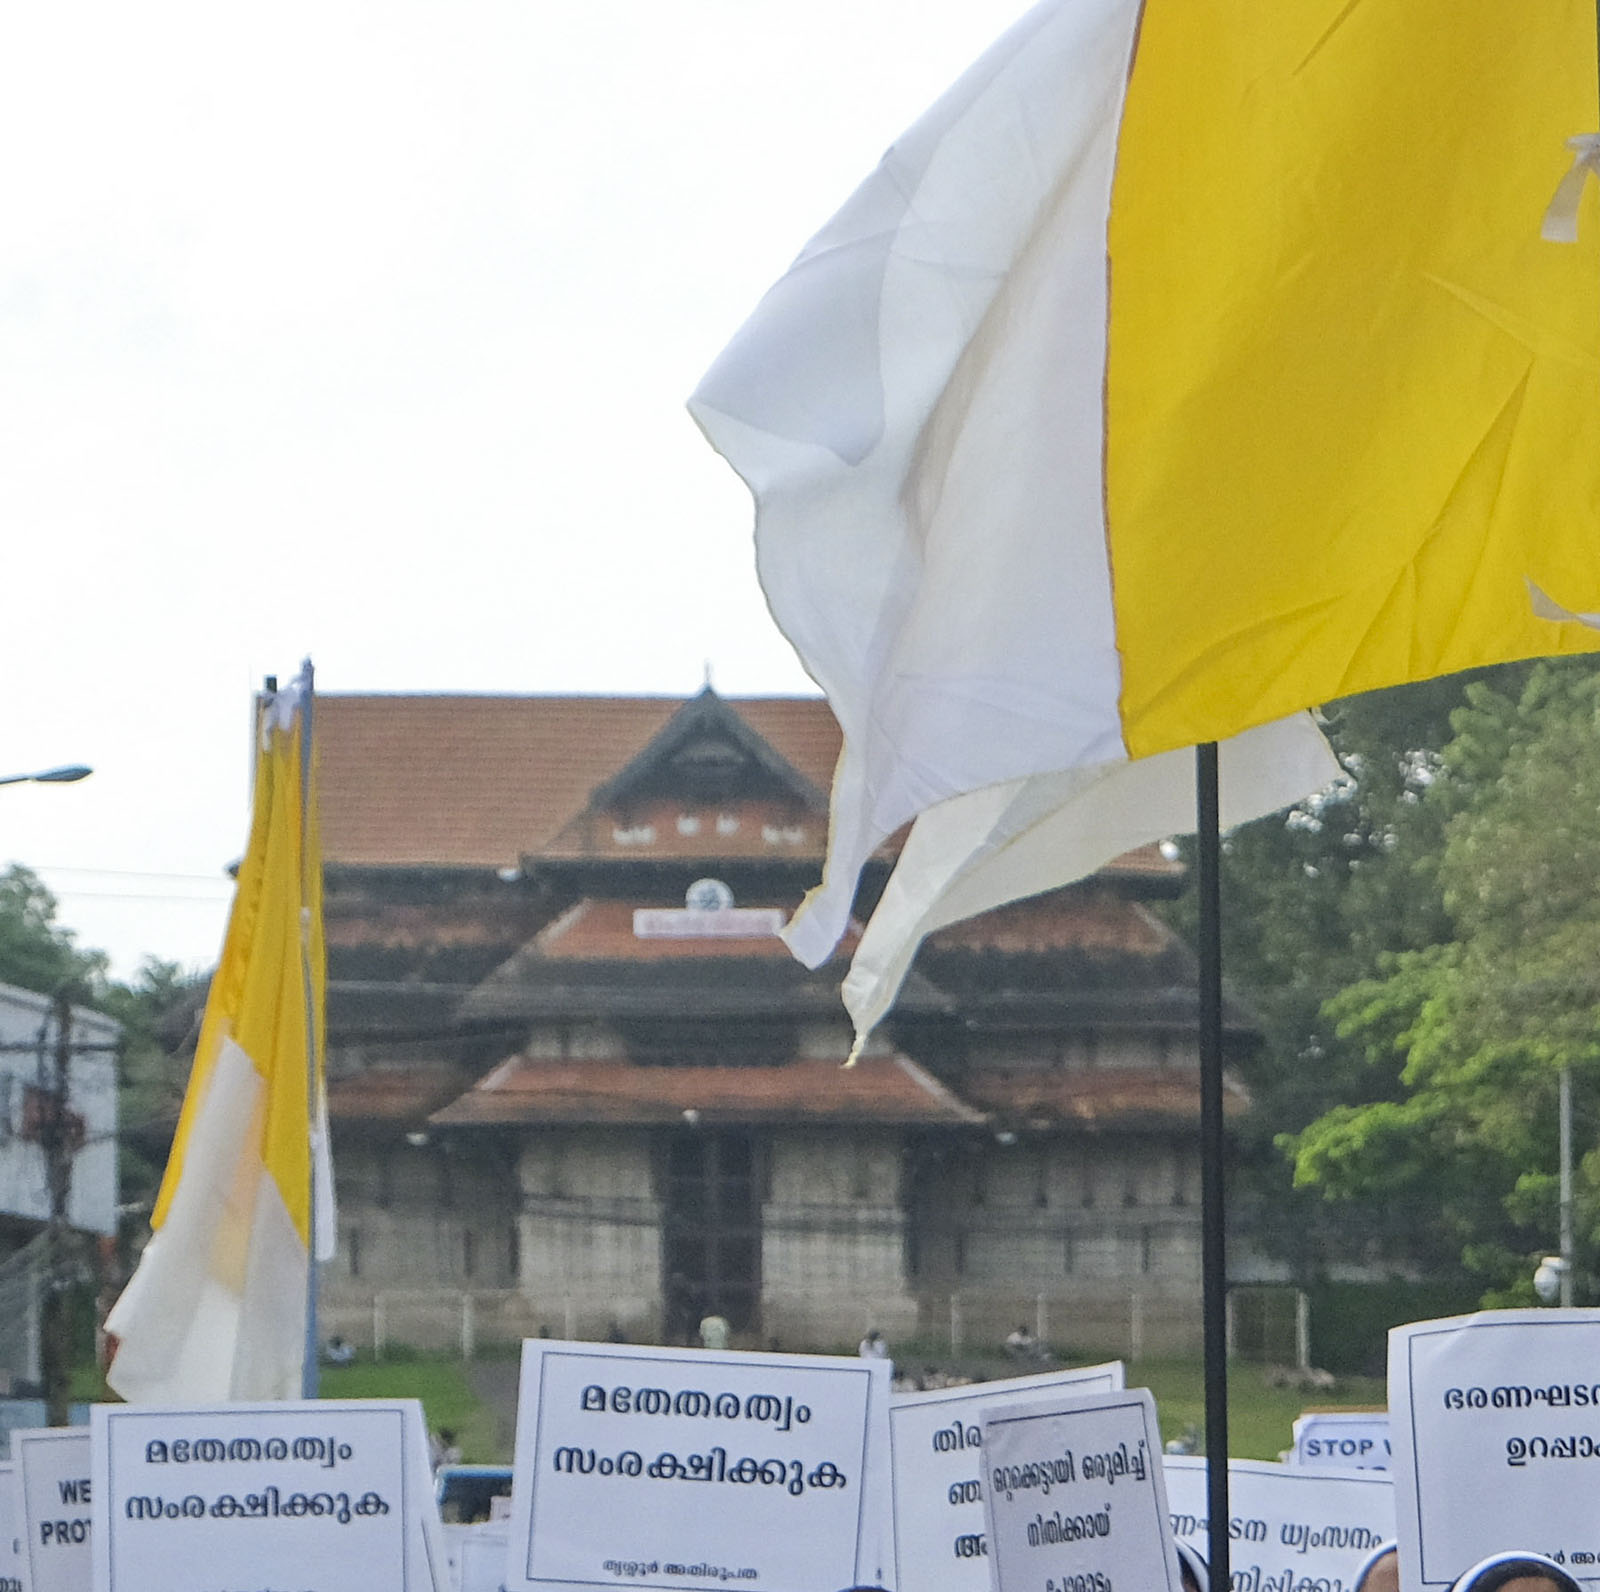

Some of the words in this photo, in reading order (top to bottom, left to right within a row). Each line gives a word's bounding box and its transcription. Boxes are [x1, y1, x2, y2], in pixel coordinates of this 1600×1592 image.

[580, 1384, 812, 1431] മതേതരത്വം
[145, 1436, 353, 1468] മതേതരത്വം
[1307, 1438, 1373, 1456] STOP
[552, 1446, 848, 1495] സംരക്ഷിക്കുക
[125, 1486, 390, 1524] സംരക്ഷിക്കുക
